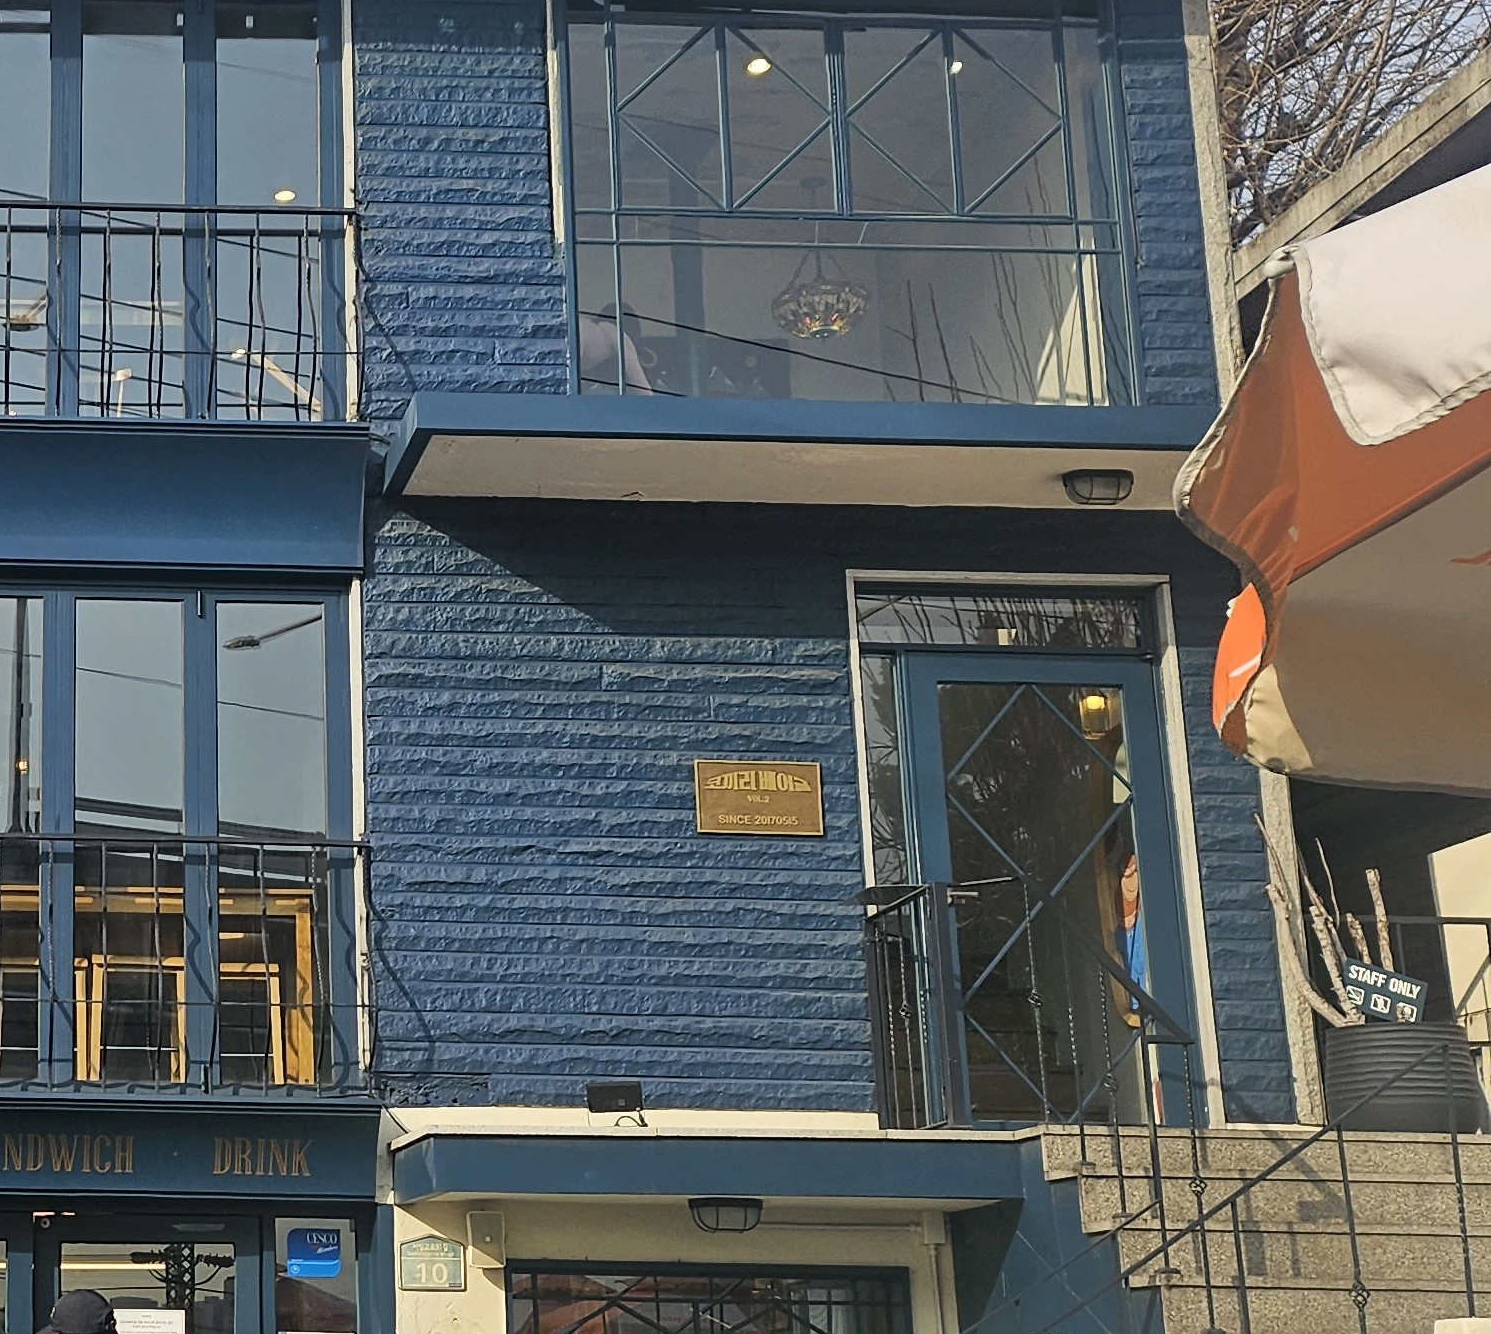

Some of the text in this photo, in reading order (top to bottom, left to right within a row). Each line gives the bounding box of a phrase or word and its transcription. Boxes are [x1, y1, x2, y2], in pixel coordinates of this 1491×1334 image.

[718, 814, 799, 826] SINCE 20170515
[1348, 964, 1422, 1000] STAFF ONLY
[212, 1137, 314, 1177] DRINK
[416, 1262, 448, 1284] 10
